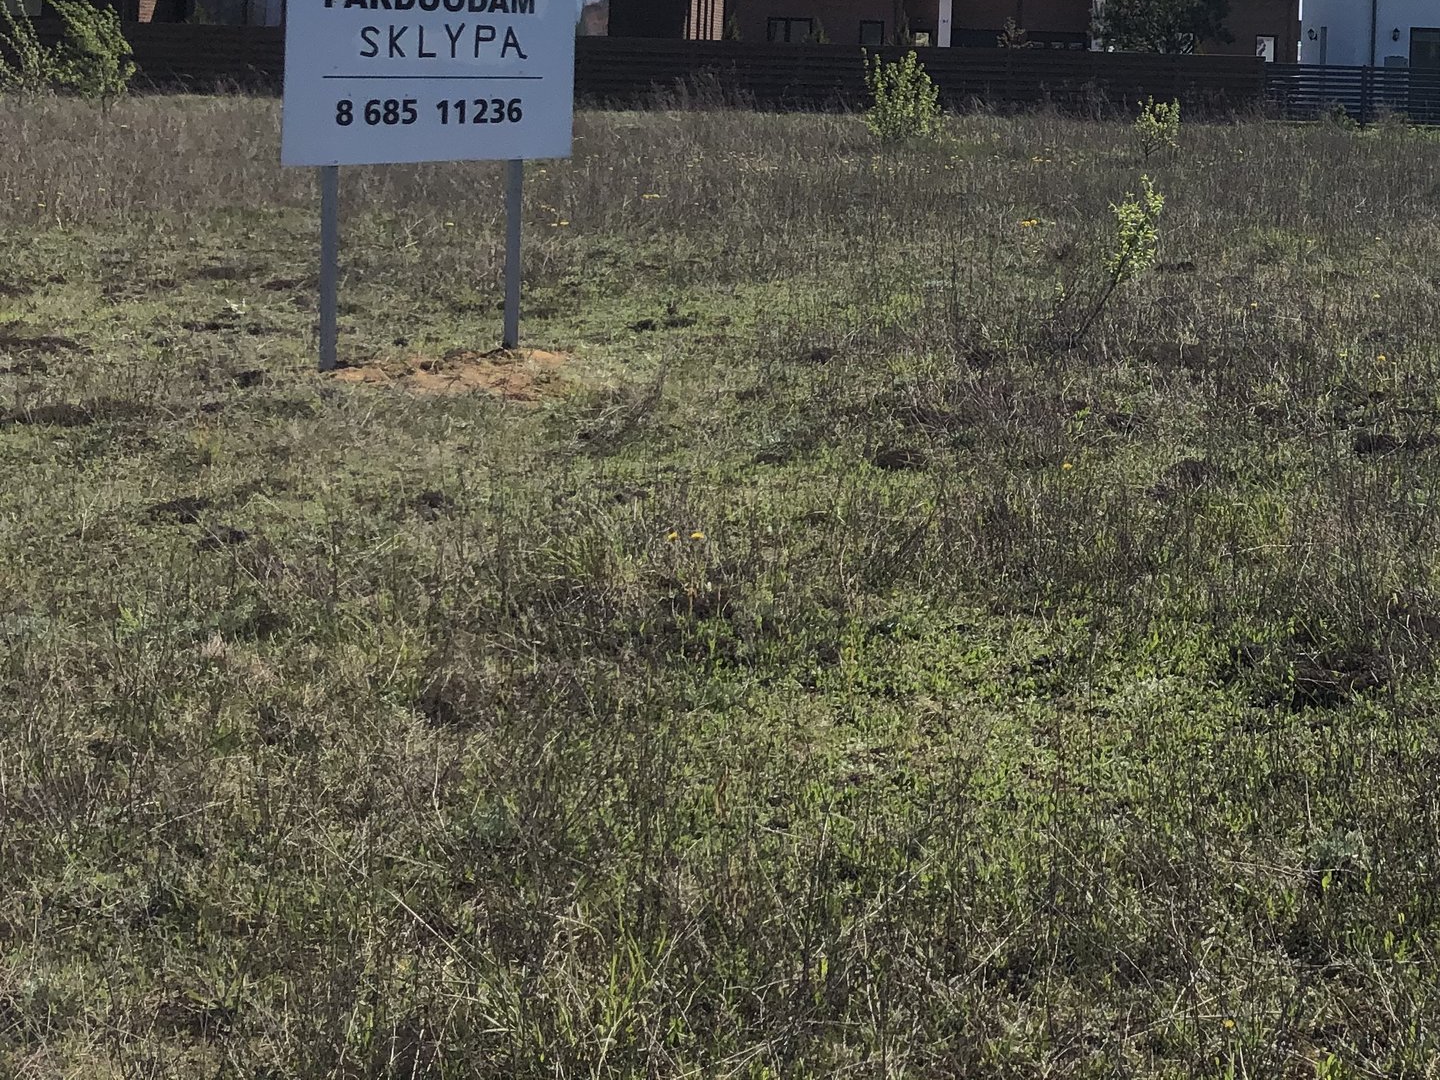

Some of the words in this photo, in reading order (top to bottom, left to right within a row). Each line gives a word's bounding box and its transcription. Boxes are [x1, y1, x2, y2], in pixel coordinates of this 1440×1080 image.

[359, 23, 528, 60] SKLYPA
[335, 99, 354, 126] 8
[364, 99, 418, 126] 685
[436, 98, 523, 125] 11236
